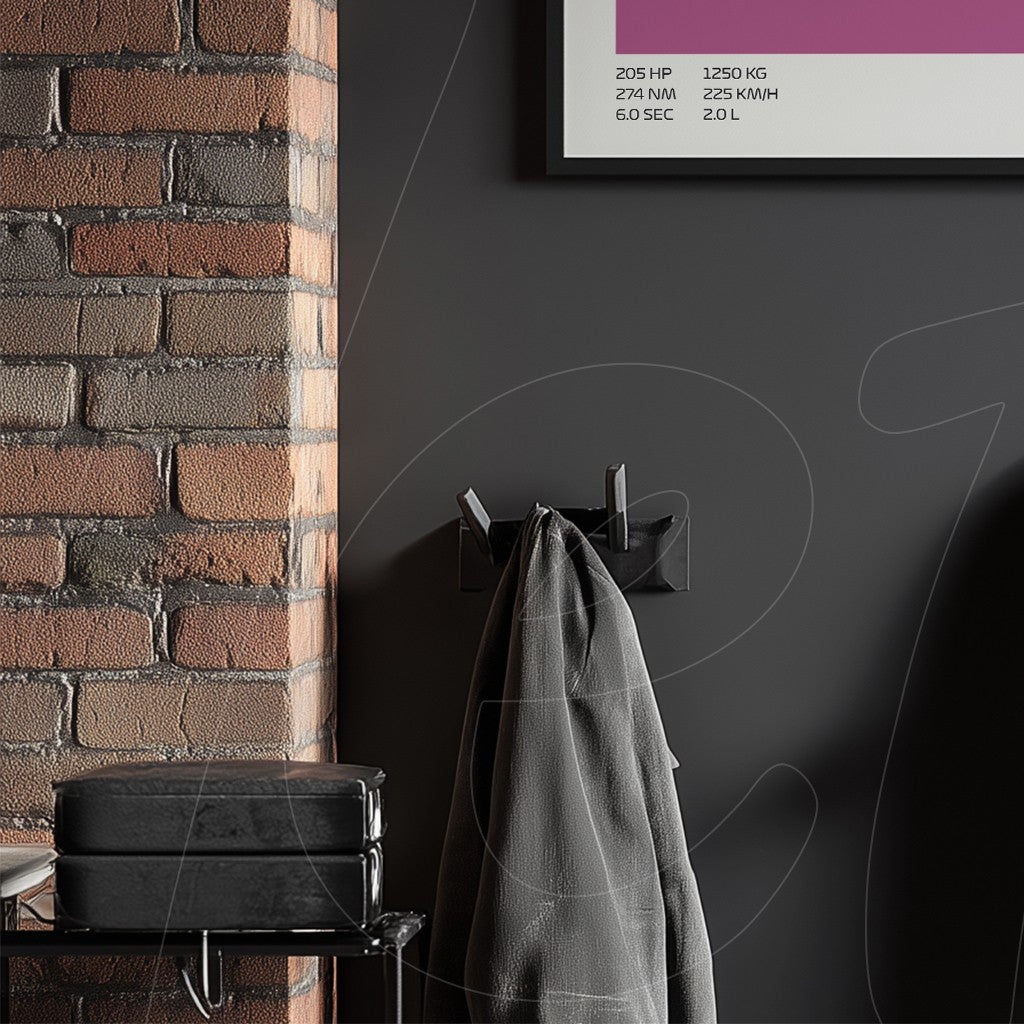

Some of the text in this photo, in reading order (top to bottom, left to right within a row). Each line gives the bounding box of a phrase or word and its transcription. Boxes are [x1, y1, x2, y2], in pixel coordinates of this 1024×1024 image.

[615, 67, 673, 80] 205 HP
[703, 67, 767, 80] 1250 KG
[615, 87, 677, 100] 274 NM
[703, 87, 779, 102] 225 KM/H
[615, 108, 674, 121] 6.0 SEC
[703, 108, 740, 121] 2.0 L
